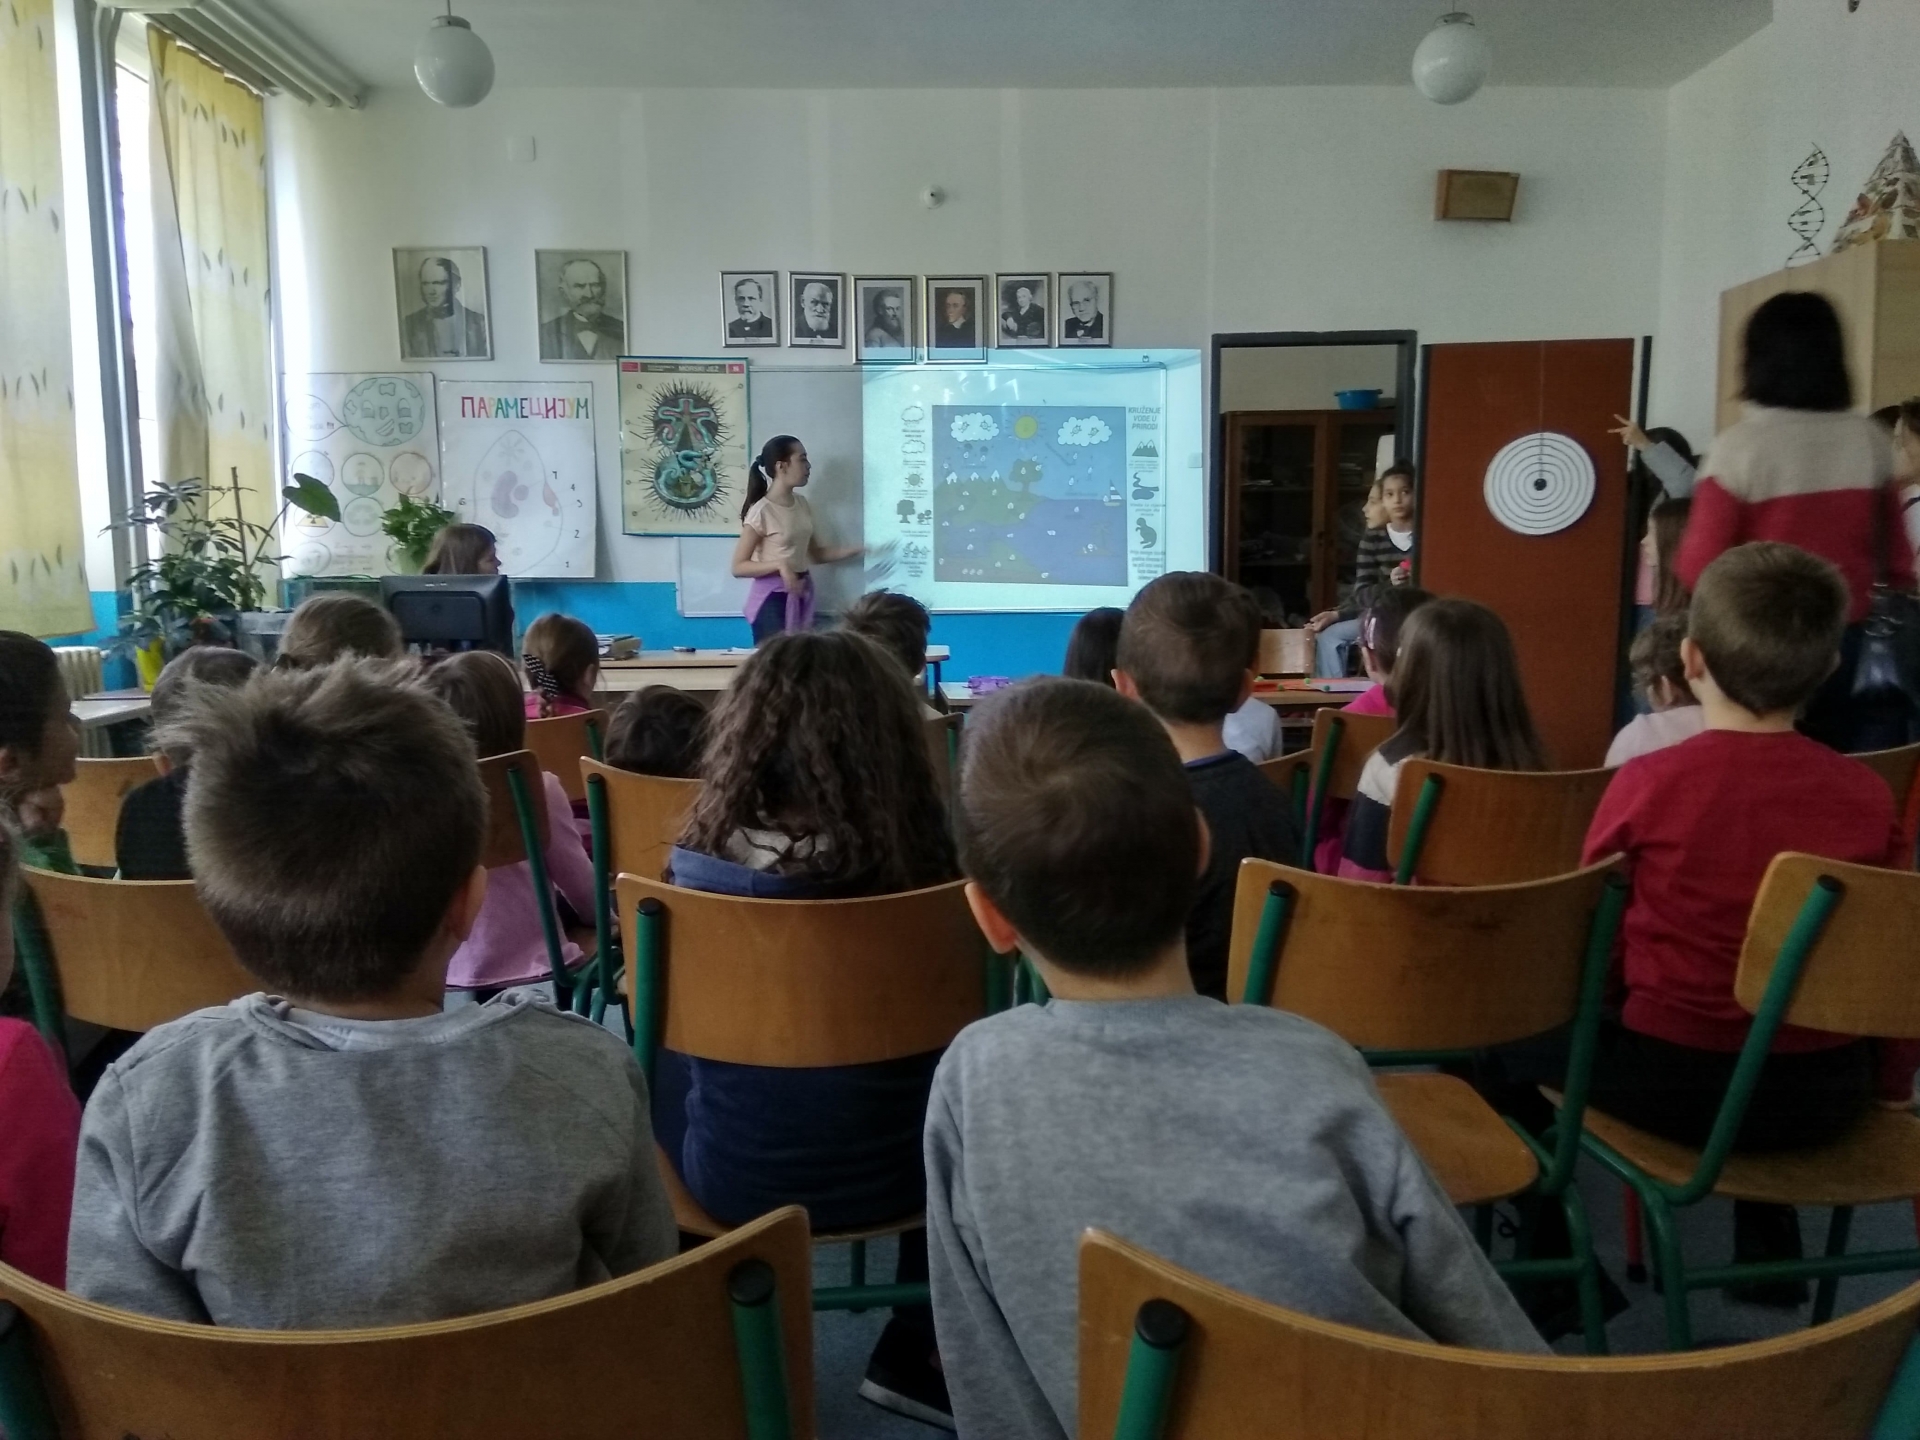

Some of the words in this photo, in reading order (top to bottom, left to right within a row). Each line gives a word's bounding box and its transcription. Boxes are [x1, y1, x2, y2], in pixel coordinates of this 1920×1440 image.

[461, 396, 589, 419] ПАРАМЕЦИЈУМ
[1128, 405, 1161, 414] KRUŽENJE
[574, 529, 580, 538] 2
